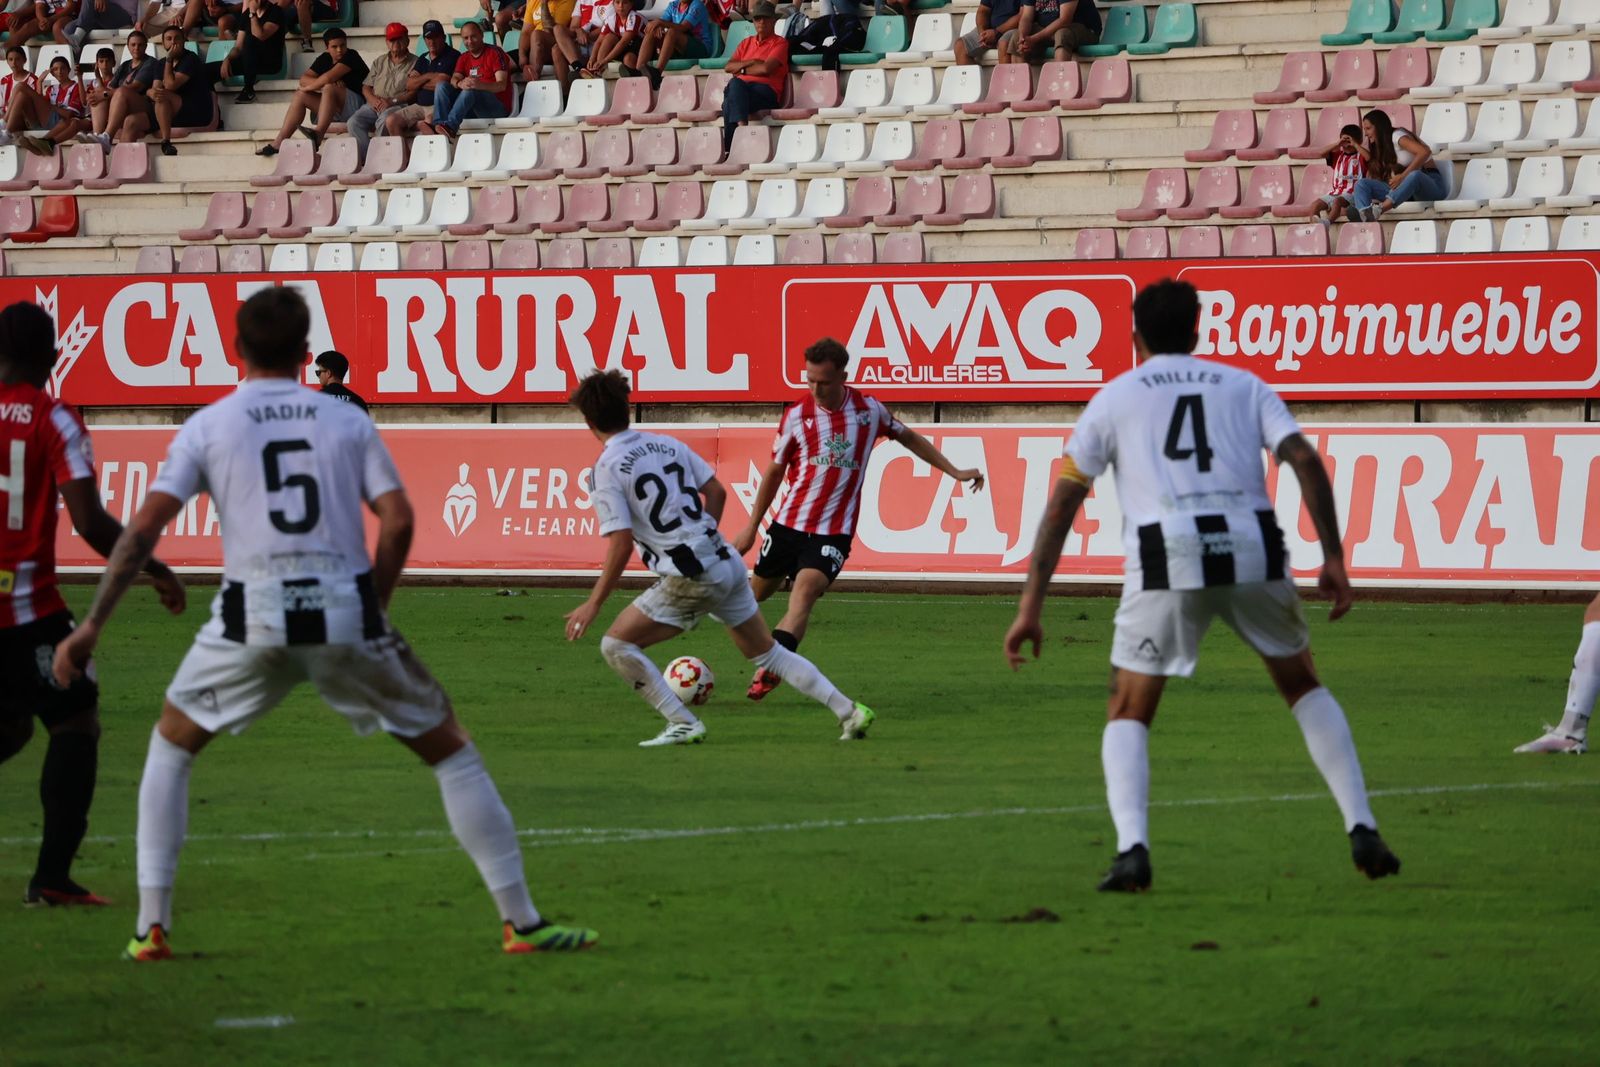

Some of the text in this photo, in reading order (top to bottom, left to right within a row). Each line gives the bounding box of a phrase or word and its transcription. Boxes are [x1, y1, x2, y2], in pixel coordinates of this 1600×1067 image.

[103, 273, 749, 396] CAA RURAL
[801, 283, 1103, 383] AMAQ
[1194, 285, 1582, 372] Rapimueble
[861, 364, 1003, 384] ALQUILERES
[1140, 371, 1223, 389] TRILLES
[245, 403, 318, 424] VADIK
[1163, 392, 1214, 475] 4
[262, 439, 321, 535] 5
[619, 442, 676, 475] MANU RICO
[502, 517, 602, 536] E-LEARN
[635, 462, 703, 534] 23
